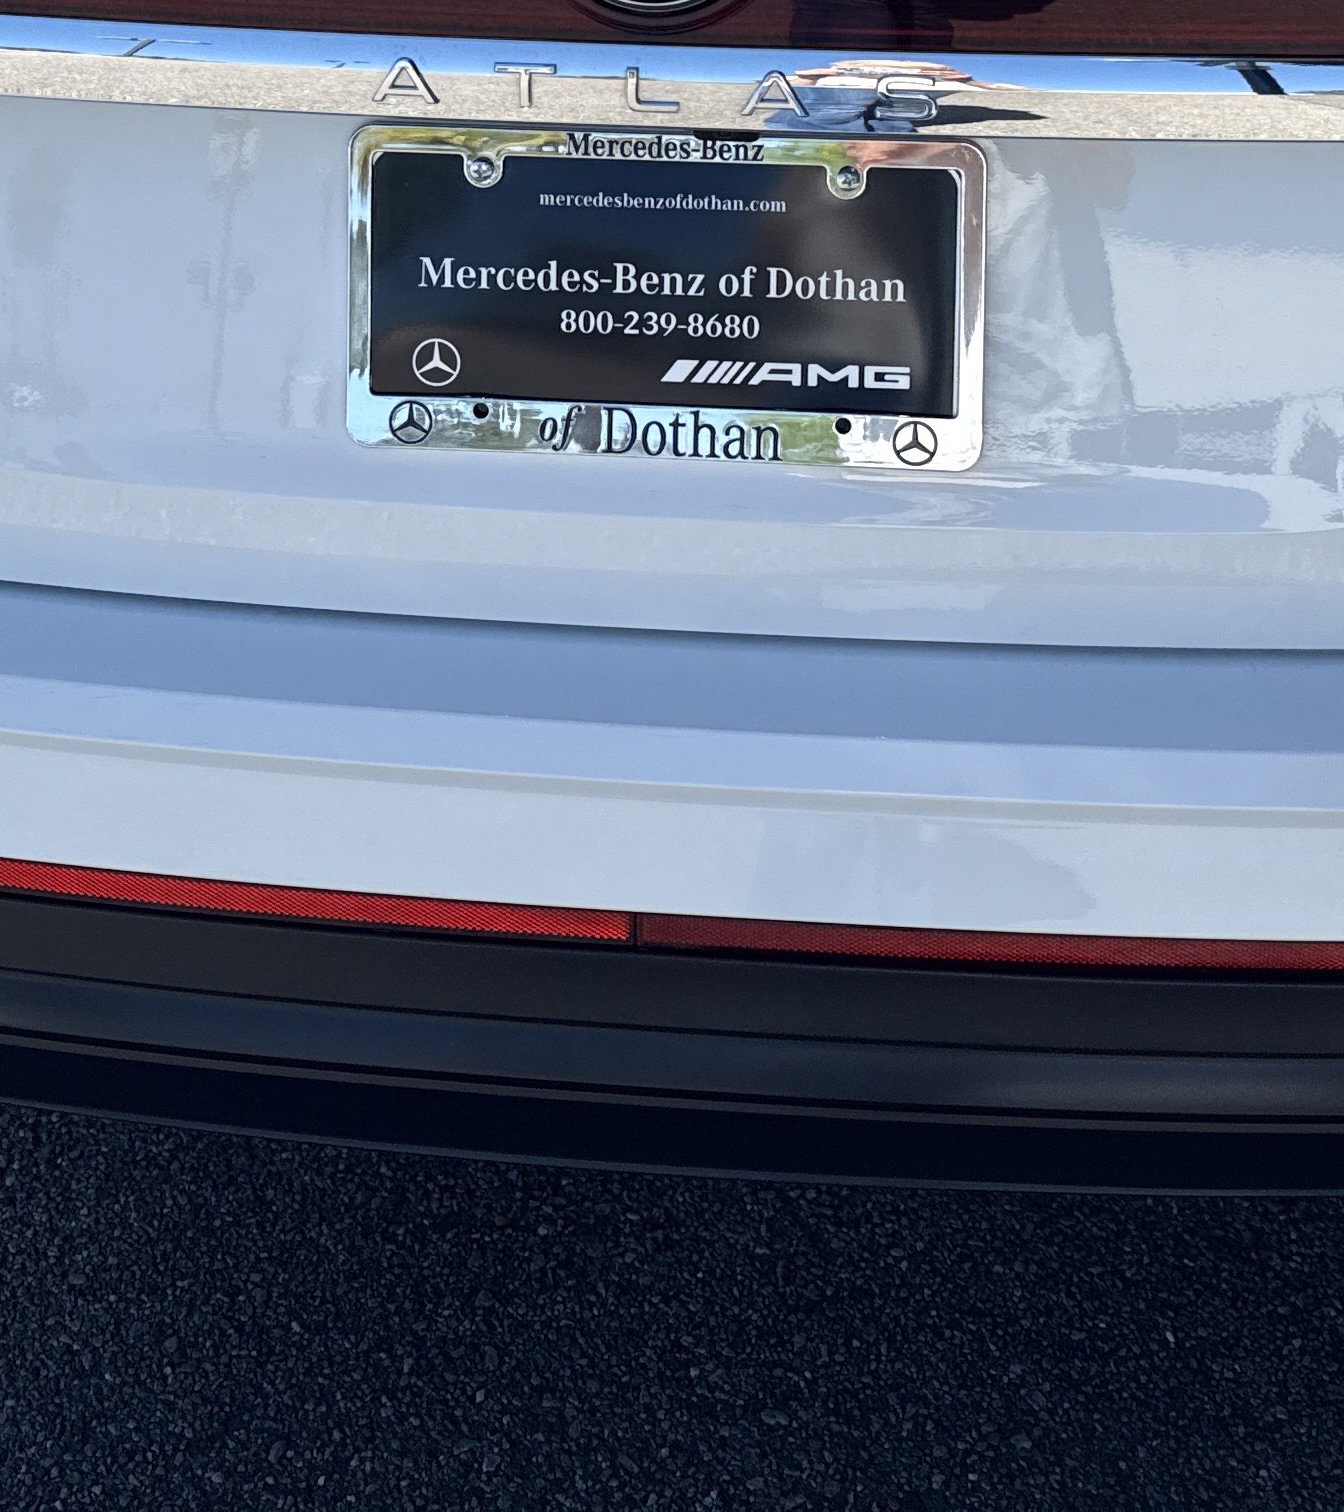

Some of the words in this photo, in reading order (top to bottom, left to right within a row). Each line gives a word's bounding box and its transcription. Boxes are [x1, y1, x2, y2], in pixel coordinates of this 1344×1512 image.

[372, 56, 940, 122] ATLAS
[566, 132, 764, 162] Mercedes-Benz
[539, 192, 787, 213] mercedesbenzofdothan.com
[418, 255, 706, 298] Mercedes-Benz
[718, 266, 758, 299] of
[766, 266, 907, 304] Dothan
[559, 309, 760, 340] 800-239-8680
[748, 362, 911, 390] AMG
[539, 405, 582, 452] of
[605, 406, 783, 462] Dothan
